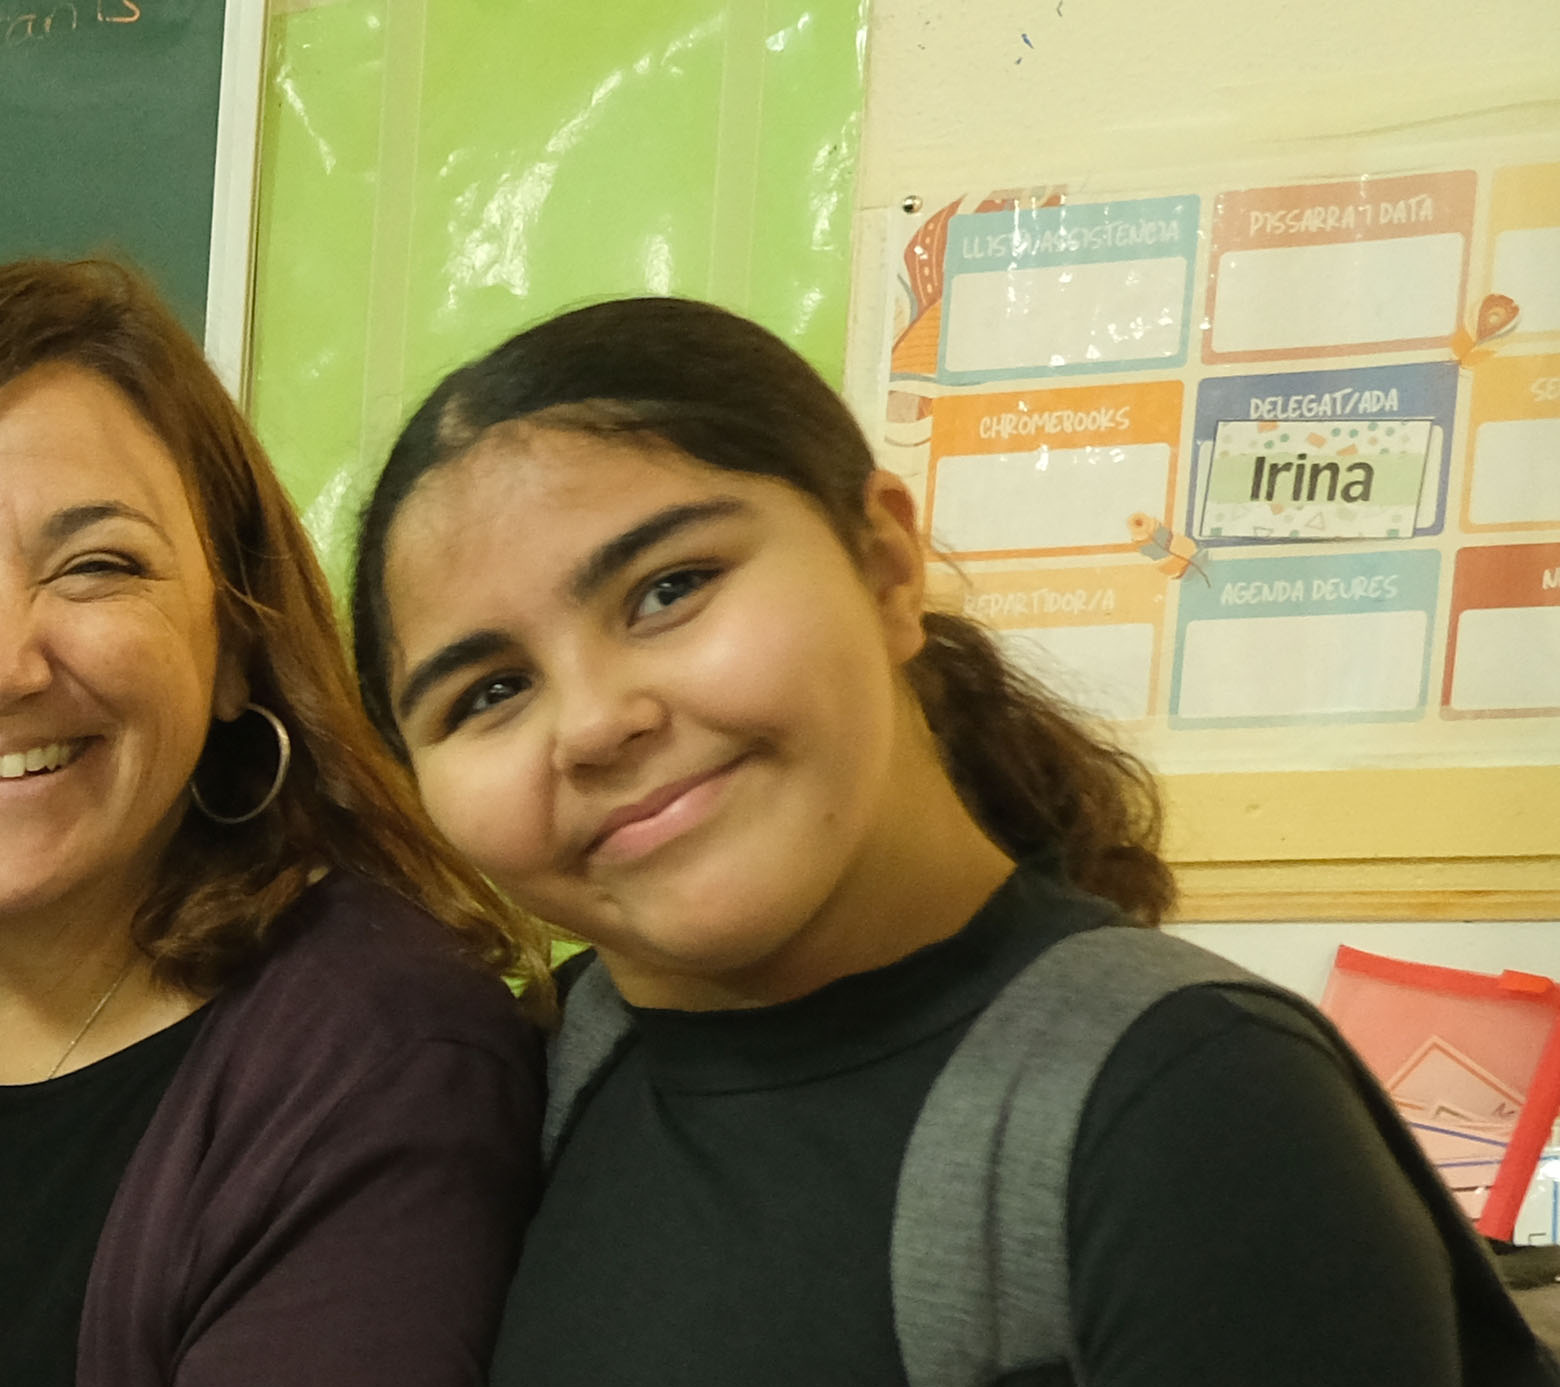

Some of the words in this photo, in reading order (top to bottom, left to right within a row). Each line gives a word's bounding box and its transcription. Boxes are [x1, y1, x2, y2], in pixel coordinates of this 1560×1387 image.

[1249, 204, 1355, 238] PISSARRA
[1378, 193, 1433, 225] DATA
[1250, 389, 1398, 419] DELEGAT/ADA
[979, 407, 1131, 439] CHROMEBOOKS
[1249, 454, 1375, 503] Irina
[1221, 580, 1304, 606] AGENDA
[1312, 574, 1399, 601] DEURES
